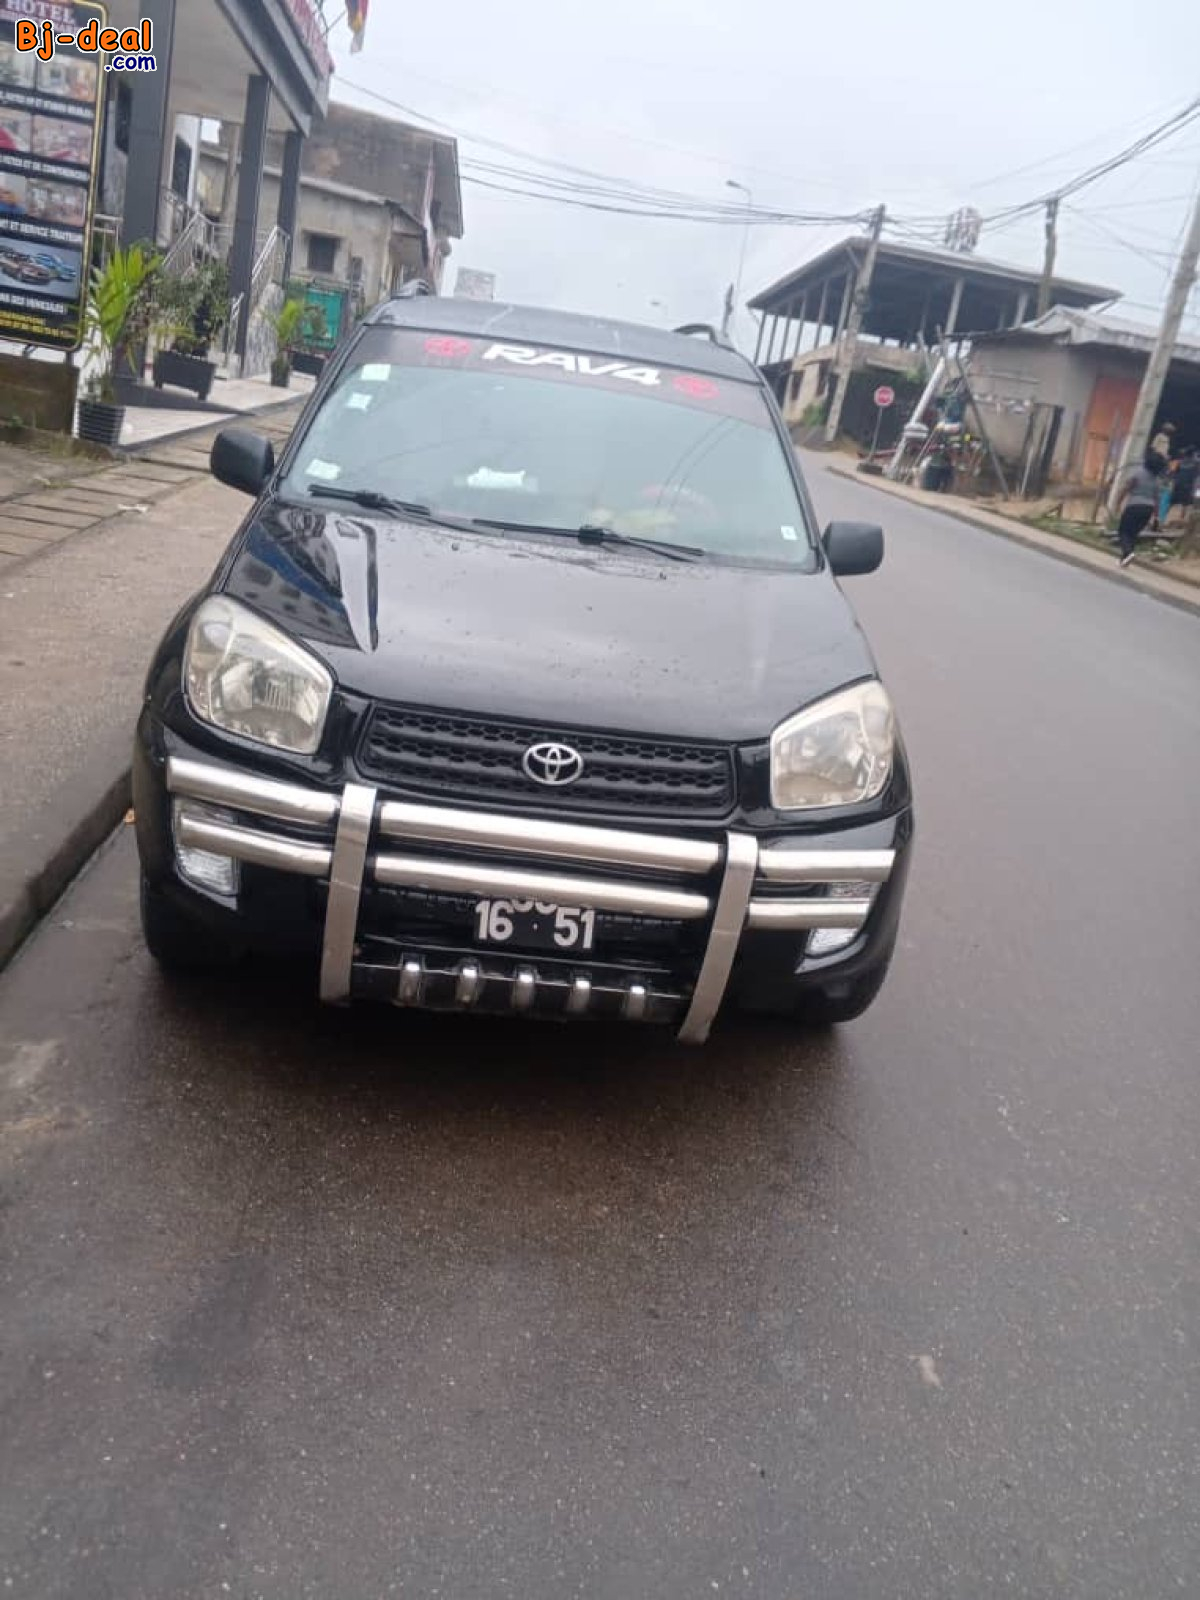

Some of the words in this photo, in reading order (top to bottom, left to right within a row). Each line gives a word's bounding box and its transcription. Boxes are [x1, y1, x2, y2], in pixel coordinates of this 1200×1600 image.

[482, 343, 661, 386] RAV4
[475, 900, 515, 941] 16
[553, 906, 595, 949] 51
